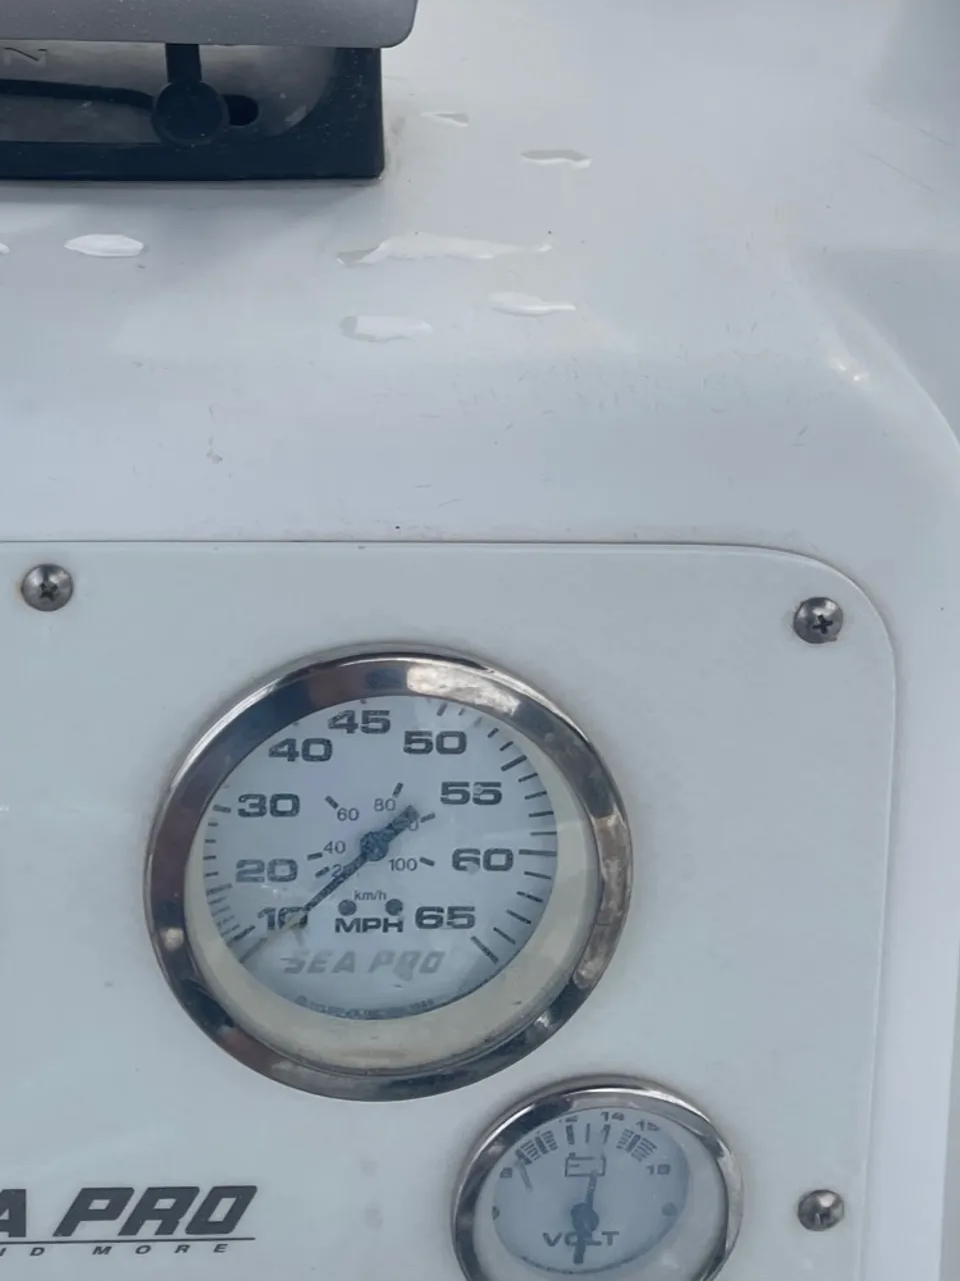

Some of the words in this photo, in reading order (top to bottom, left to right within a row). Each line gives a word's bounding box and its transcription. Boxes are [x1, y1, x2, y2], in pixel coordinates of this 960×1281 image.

[327, 709, 391, 735] 45
[268, 737, 334, 763] 40
[402, 730, 467, 755] 50
[236, 793, 301, 818] 30
[373, 798, 397, 812] 80
[440, 781, 503, 806] 55
[336, 808, 360, 822] 60
[323, 840, 346, 855] 40
[451, 847, 515, 873] 60
[236, 858, 299, 884] 20
[388, 857, 418, 872] 100
[354, 890, 387, 901] km/h
[256, 906, 309, 931] 10
[334, 917, 404, 934] MPH
[414, 905, 477, 930] 65
[279, 950, 357, 974] SEA
[52, 1185, 258, 1237] PRO
[91, 1243, 229, 1257] MORE
[542, 1229, 621, 1248] VOLT
